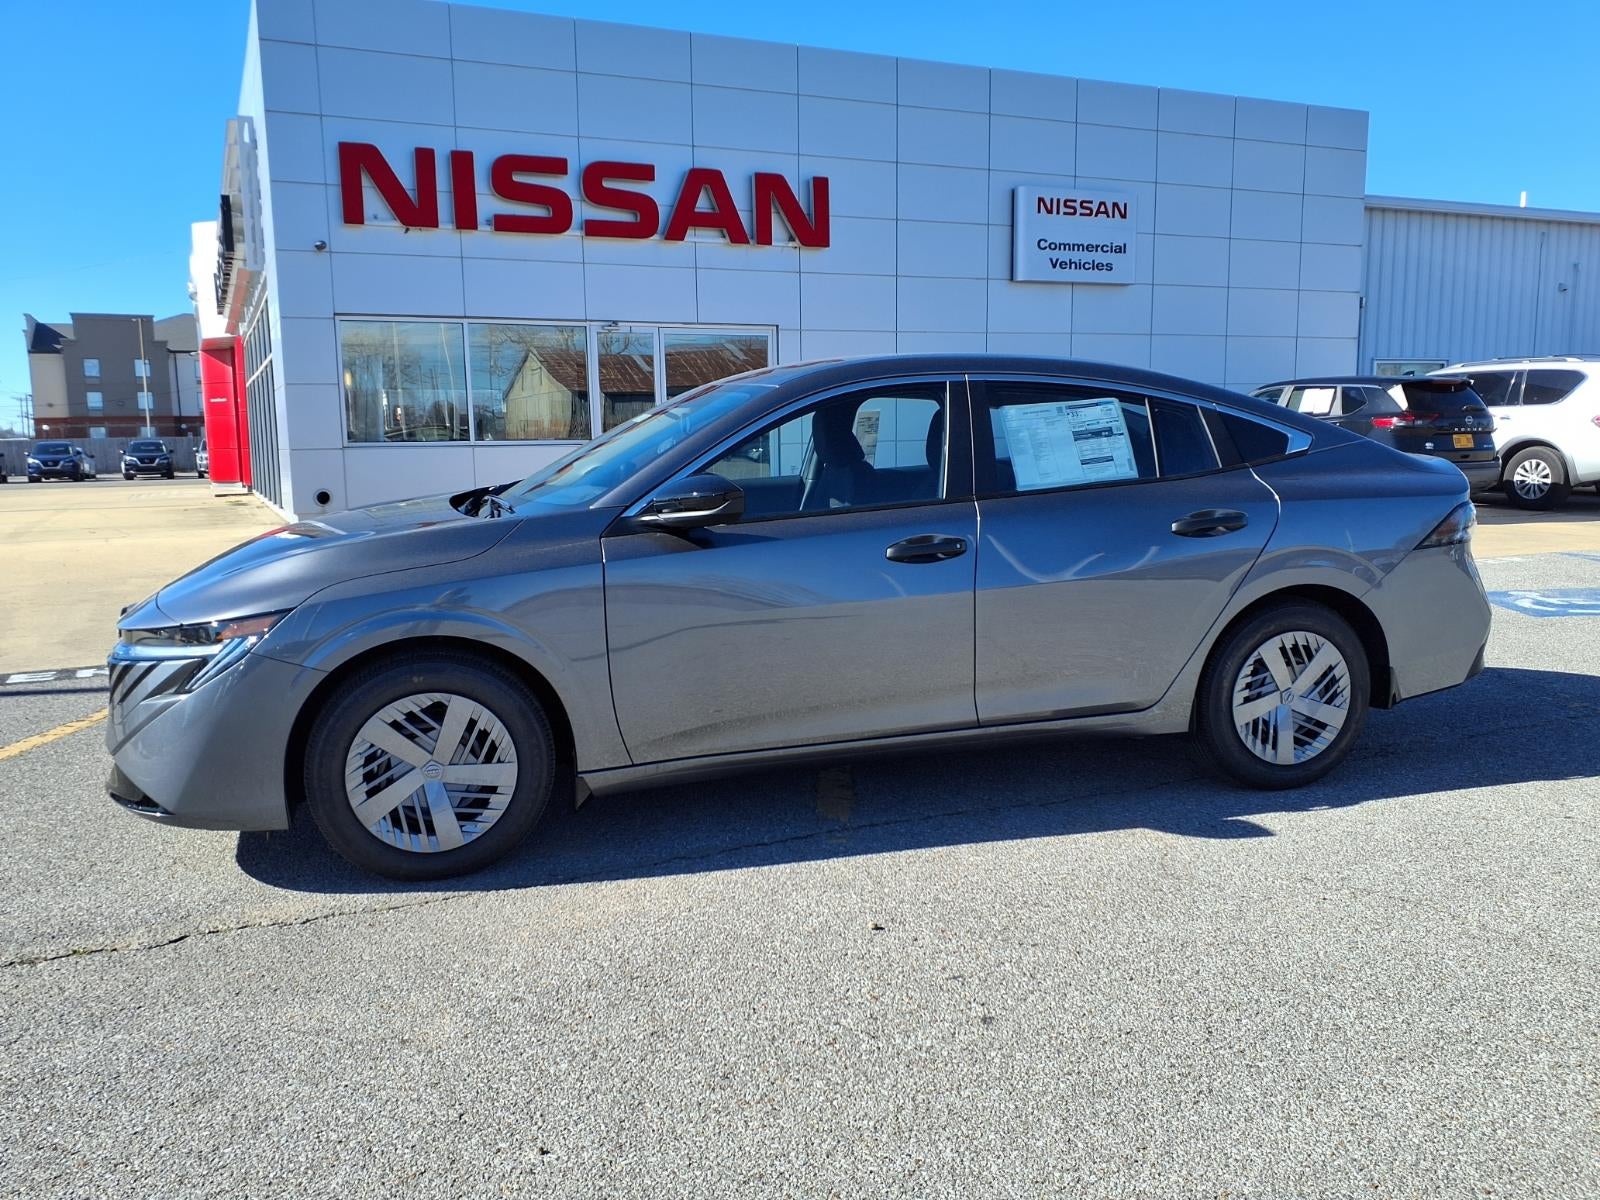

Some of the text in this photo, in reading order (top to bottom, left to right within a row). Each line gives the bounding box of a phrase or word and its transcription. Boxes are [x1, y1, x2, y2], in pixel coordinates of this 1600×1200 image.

[338, 141, 830, 248] NISSAN
[1037, 196, 1128, 220] NISSAN
[1036, 238, 1127, 254] Commercial
[1049, 257, 1114, 272] Vehicles
